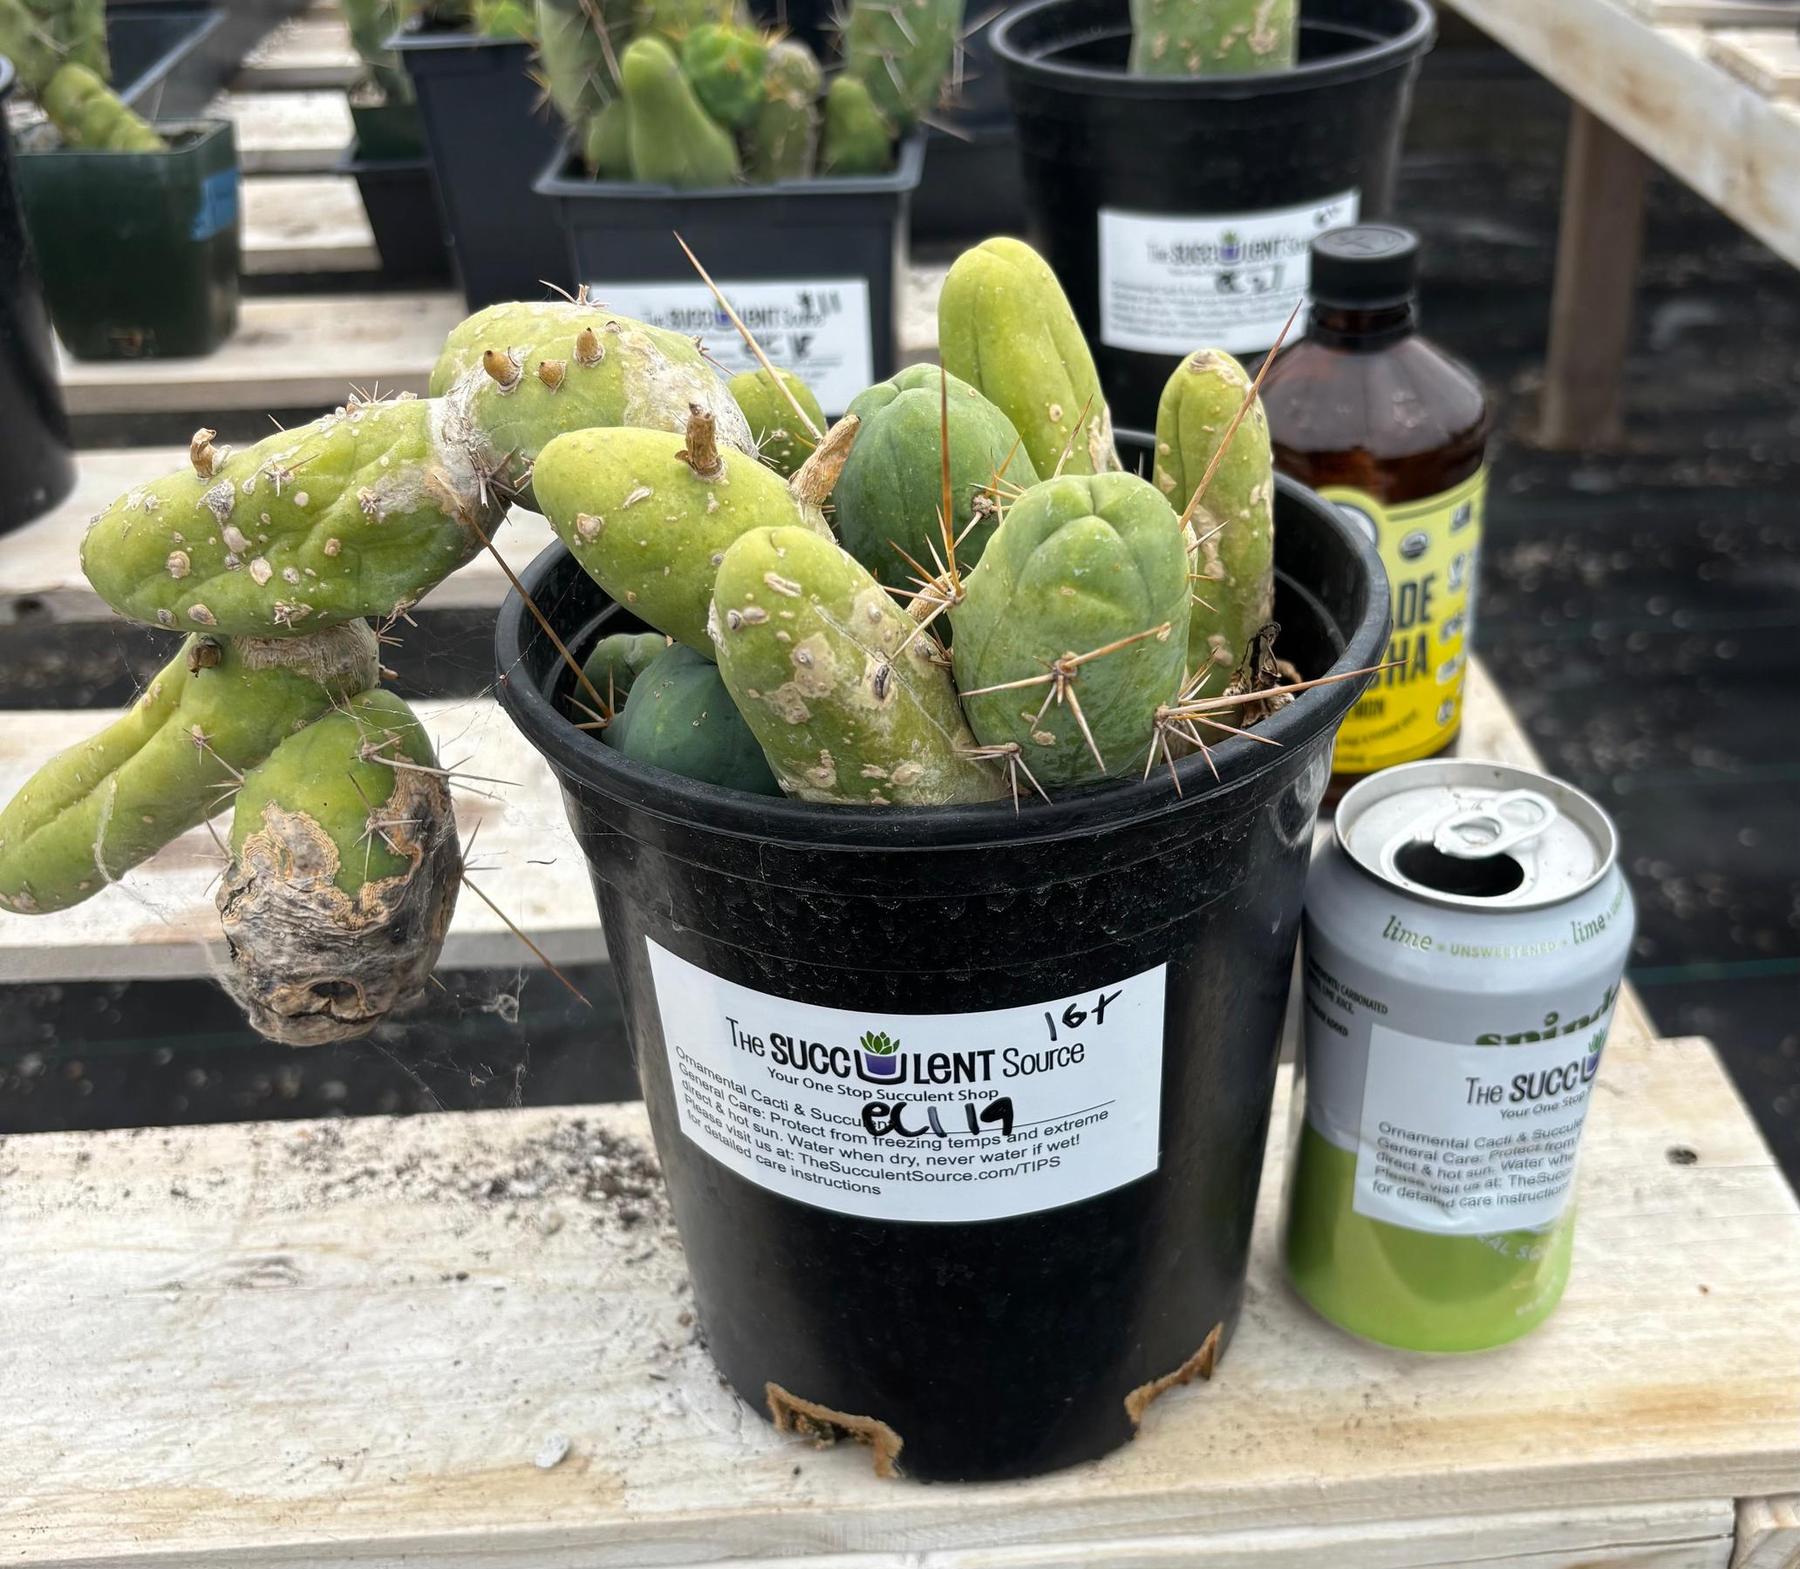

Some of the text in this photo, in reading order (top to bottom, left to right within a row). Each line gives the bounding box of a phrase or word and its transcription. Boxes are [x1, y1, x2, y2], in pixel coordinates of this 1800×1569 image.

[1372, 634, 1429, 690] HA
[1382, 914, 1606, 959] lime UNSWEETENED lime
[1003, 1042, 1085, 1078] Source
[675, 1045, 747, 1096] Ornamental
[751, 1089, 789, 1111] Cacti
[794, 1103, 806, 1116] &
[767, 1066, 999, 1102] Your One Stop Succulent Shop
[679, 1062, 1109, 1151] General Care: Protect from freezing temps and extreme
[1500, 1091, 1586, 1120] Your One Stop
[682, 1080, 1081, 1168] direct & hot sun. Water when dry, never water if wet!
[684, 1093, 1061, 1182] Please visit us at: TheSucculentSource.com/TIPS
[1378, 1121, 1469, 1149] Ornamental
[1474, 1135, 1512, 1149] Cacti
[1516, 1132, 1527, 1142] &
[687, 1109, 881, 1195] for detailed care instructions
[1376, 1151, 1416, 1173] direct
[1421, 1164, 1432, 1177] &
[1437, 1167, 1462, 1181] hot
[1501, 1157, 1545, 1171] Water
[1377, 1136, 1437, 1161] General
[1489, 1144, 1541, 1160] Protect
[1545, 1137, 1575, 1150] from
[1372, 1179, 1392, 1194] for
[1459, 1195, 1492, 1208] care
[1430, 1183, 1459, 1195] visit
[1463, 1182, 1480, 1193] us
